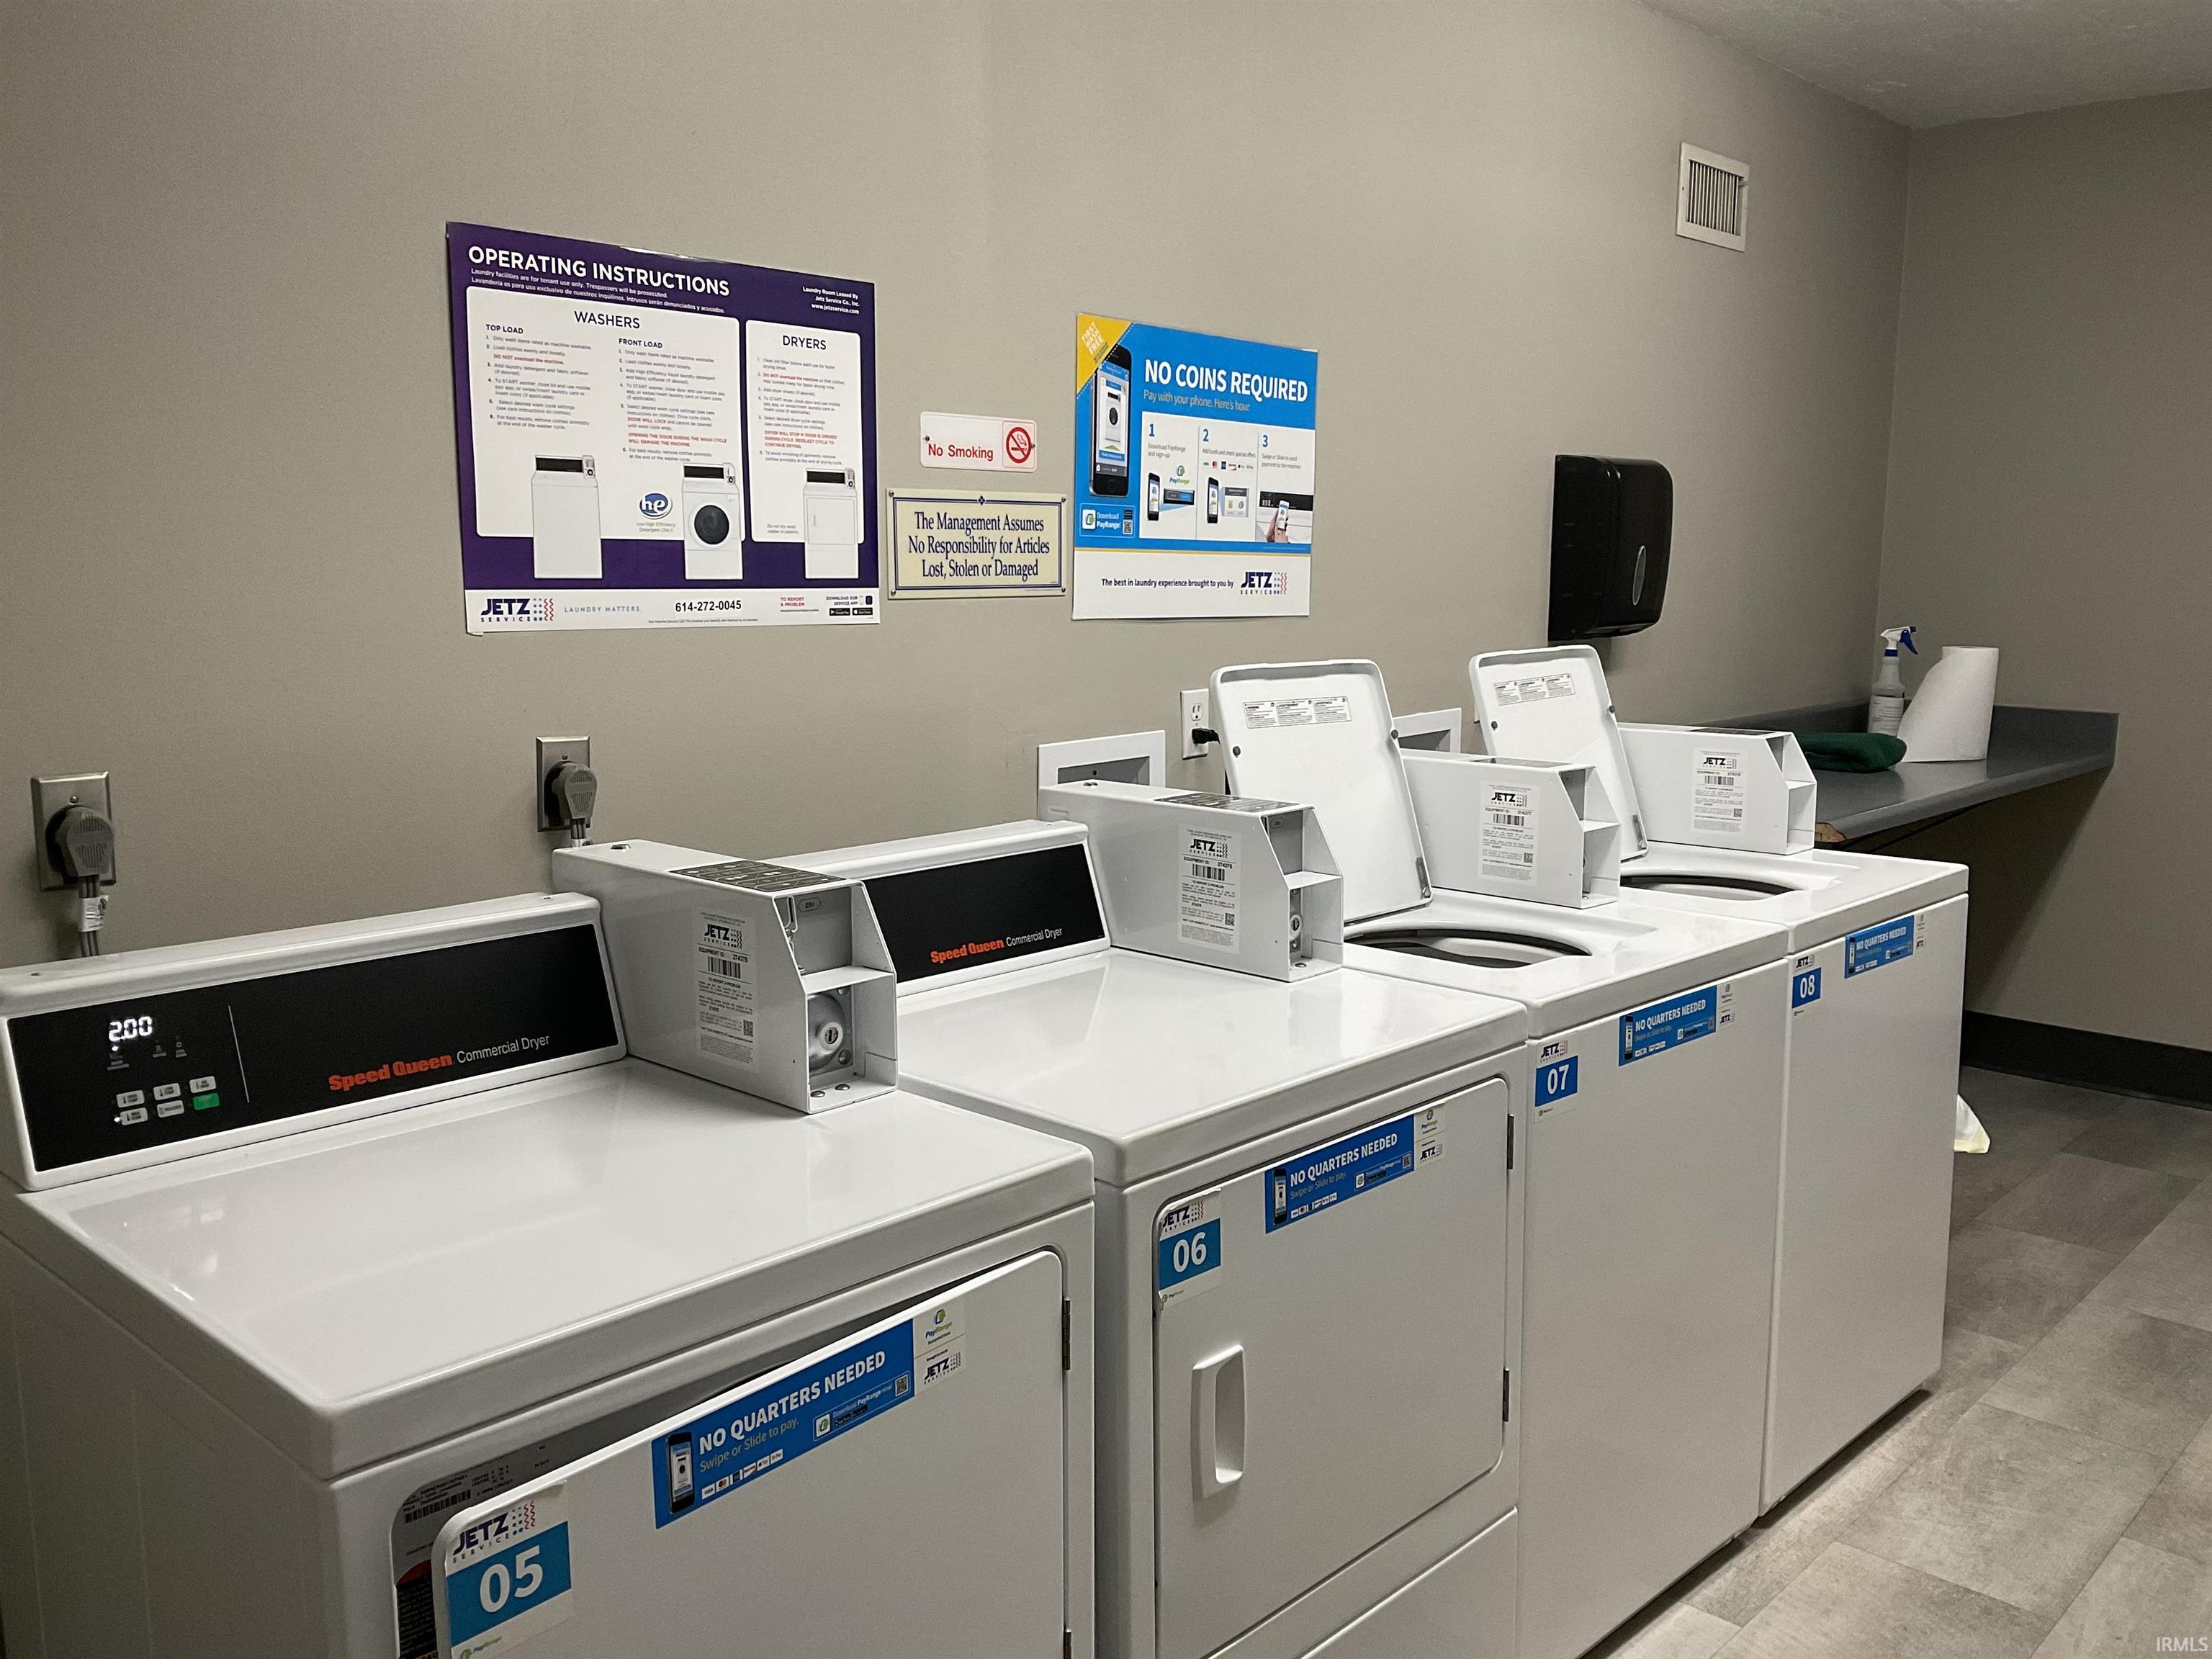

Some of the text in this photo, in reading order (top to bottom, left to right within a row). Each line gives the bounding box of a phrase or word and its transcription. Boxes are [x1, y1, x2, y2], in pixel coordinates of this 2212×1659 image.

[468, 246, 730, 297] OPERATING INSTRUCTIONS
[471, 268, 494, 276] Laundry
[540, 277, 559, 286] tenant
[586, 282, 618, 292] Trespassers
[637, 289, 668, 298] prosecuted.
[537, 285, 563, 294] exclusivo
[575, 311, 639, 328] WASHERS
[811, 303, 859, 314] www.jetzservice.com
[783, 336, 827, 350] DRYERS
[1145, 359, 1308, 402] NO COINS REQUIRED
[1143, 390, 1250, 411] Pay with your phone. Here's how:
[1149, 424, 1154, 436] 1
[1203, 429, 1209, 441] 2
[1262, 435, 1268, 447] 3
[928, 444, 993, 462] No Smoking
[642, 497, 665, 513] he
[914, 511, 1044, 536] The Management Assumes
[909, 536, 1050, 559] No Responsibility for Articles
[922, 559, 1038, 582] Lost, Stolen or Damaged
[1241, 572, 1272, 588] JETZ
[1135, 579, 1156, 588] laundry
[1188, 580, 1209, 588] brought
[1228, 580, 1233, 588] by
[481, 598, 531, 615] JETZ
[675, 601, 742, 611] 614-272-0045
[1492, 792, 1516, 802] JETZ
[1190, 839, 1215, 852] JETZ
[704, 924, 729, 941] JETZ
[1856, 927, 1906, 950] NO QUARTERS NEEDED
[930, 928, 1062, 963] Speed Queen Commercial Dryer
[1797, 956, 1809, 968] JETZ
[1800, 975, 1815, 998] 08
[1635, 999, 1706, 1031] NO QUARTERS NEEDED
[109, 1016, 153, 1041] 2.00
[1541, 1043, 1560, 1058] JETZ
[328, 1035, 549, 1092] Speed Queen Commercial Dryer
[1548, 1064, 1569, 1094] 07
[1290, 1133, 1397, 1187] NO QUARTERS NEEDED
[1420, 1146, 1435, 1160] JETZ
[1290, 1187, 1307, 1200] Swipe
[1315, 1178, 1328, 1190] Slide
[1174, 1232, 1207, 1272] 06
[925, 1321, 953, 1339] PayRange
[924, 1357, 949, 1380] JETZ
[699, 1350, 886, 1455] NO QUARTERS NEEDED
[833, 1402, 857, 1418] Download
[858, 1390, 881, 1405] PayRange
[700, 1417, 799, 1472] Swipe or Slide to pay.
[453, 1512, 508, 1555] JETZ
[453, 1533, 509, 1563] SERVICE
[480, 1545, 543, 1613] 05
[473, 1636, 502, 1653] PayRange
